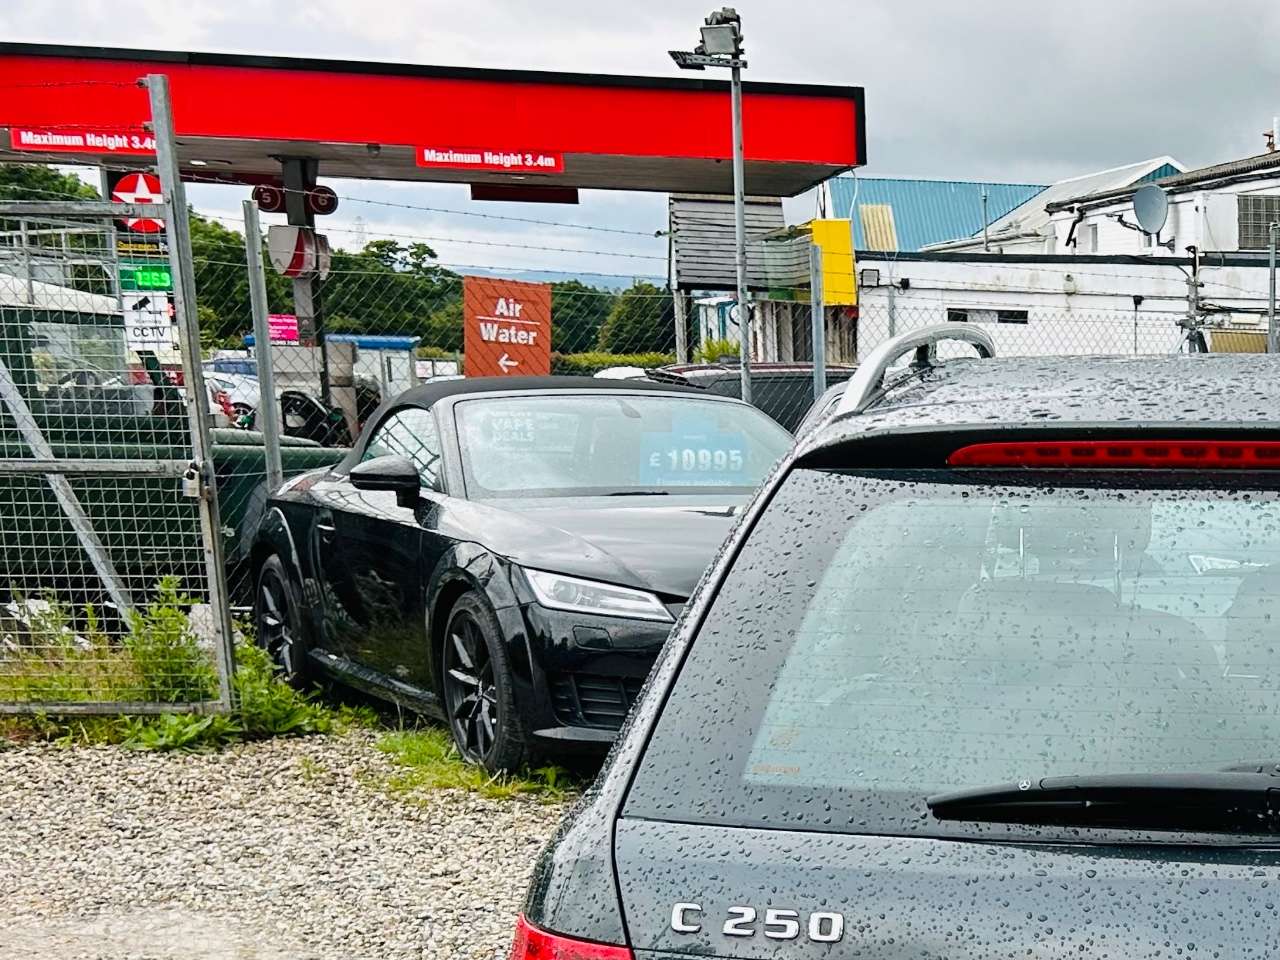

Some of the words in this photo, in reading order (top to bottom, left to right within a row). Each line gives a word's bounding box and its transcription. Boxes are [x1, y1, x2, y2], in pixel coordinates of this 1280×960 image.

[20, 131, 84, 146] Maximum
[85, 133, 129, 150] Height
[423, 149, 482, 164] Maximum
[483, 151, 523, 168] Height
[524, 153, 556, 168] 3.4m
[262, 192, 271, 203] 5
[495, 297, 523, 317] Air
[133, 326, 165, 338] CCTV
[480, 322, 538, 345] Water
[667, 449, 744, 472] 10995
[671, 902, 703, 933] C
[721, 905, 845, 943] 250
